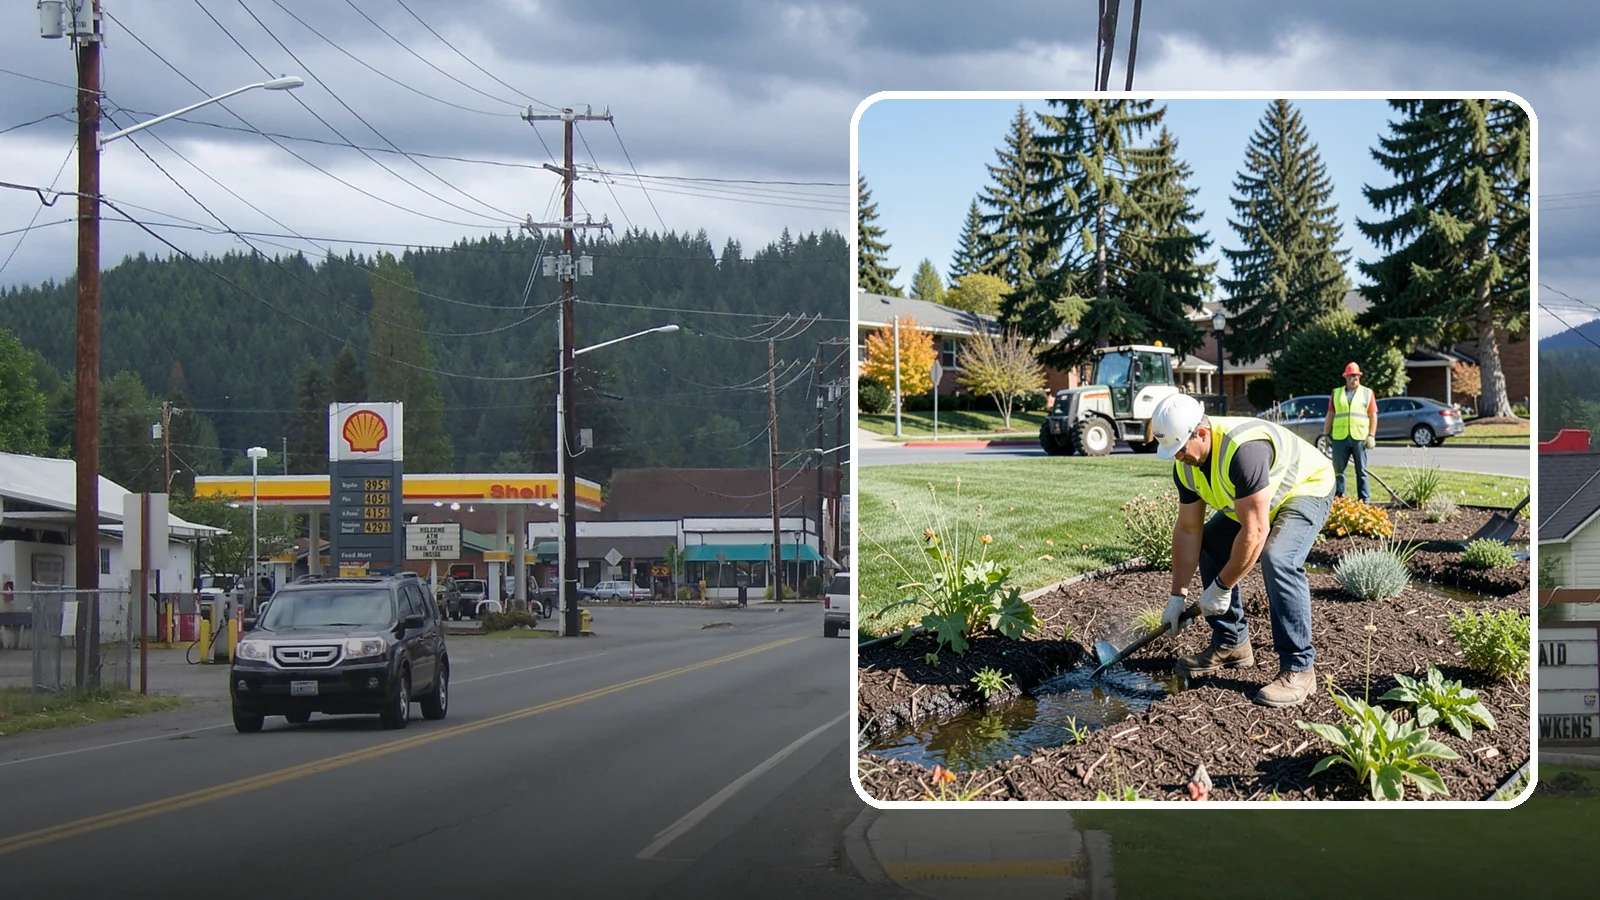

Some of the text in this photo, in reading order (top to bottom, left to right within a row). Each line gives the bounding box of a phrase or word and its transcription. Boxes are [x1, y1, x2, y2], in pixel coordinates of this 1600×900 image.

[366, 480, 383, 490] 395
[490, 484, 547, 498] Shell
[366, 494, 383, 504] 405
[366, 508, 383, 518] 415
[366, 523, 383, 532] 429
[1539, 642, 1567, 665] AID
